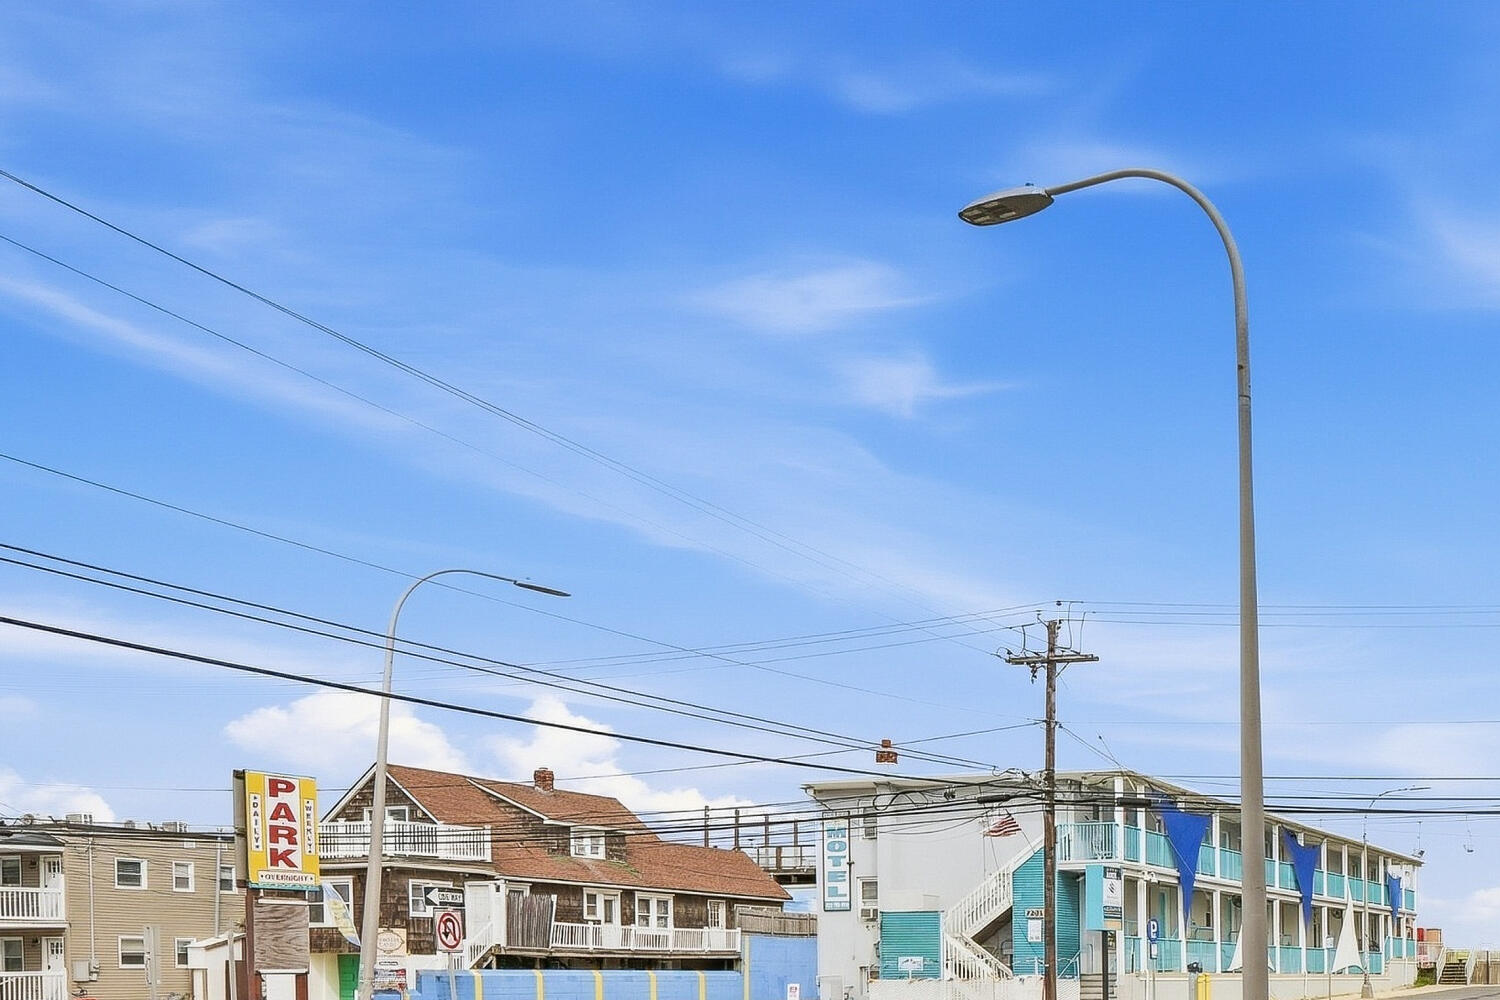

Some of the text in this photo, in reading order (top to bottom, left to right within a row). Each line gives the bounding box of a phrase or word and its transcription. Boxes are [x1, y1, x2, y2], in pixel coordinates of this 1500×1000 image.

[252, 801, 260, 844] DAILY
[268, 778, 298, 868] PARK
[305, 805, 313, 849] WEEKLY
[826, 827, 847, 897] MOTEL
